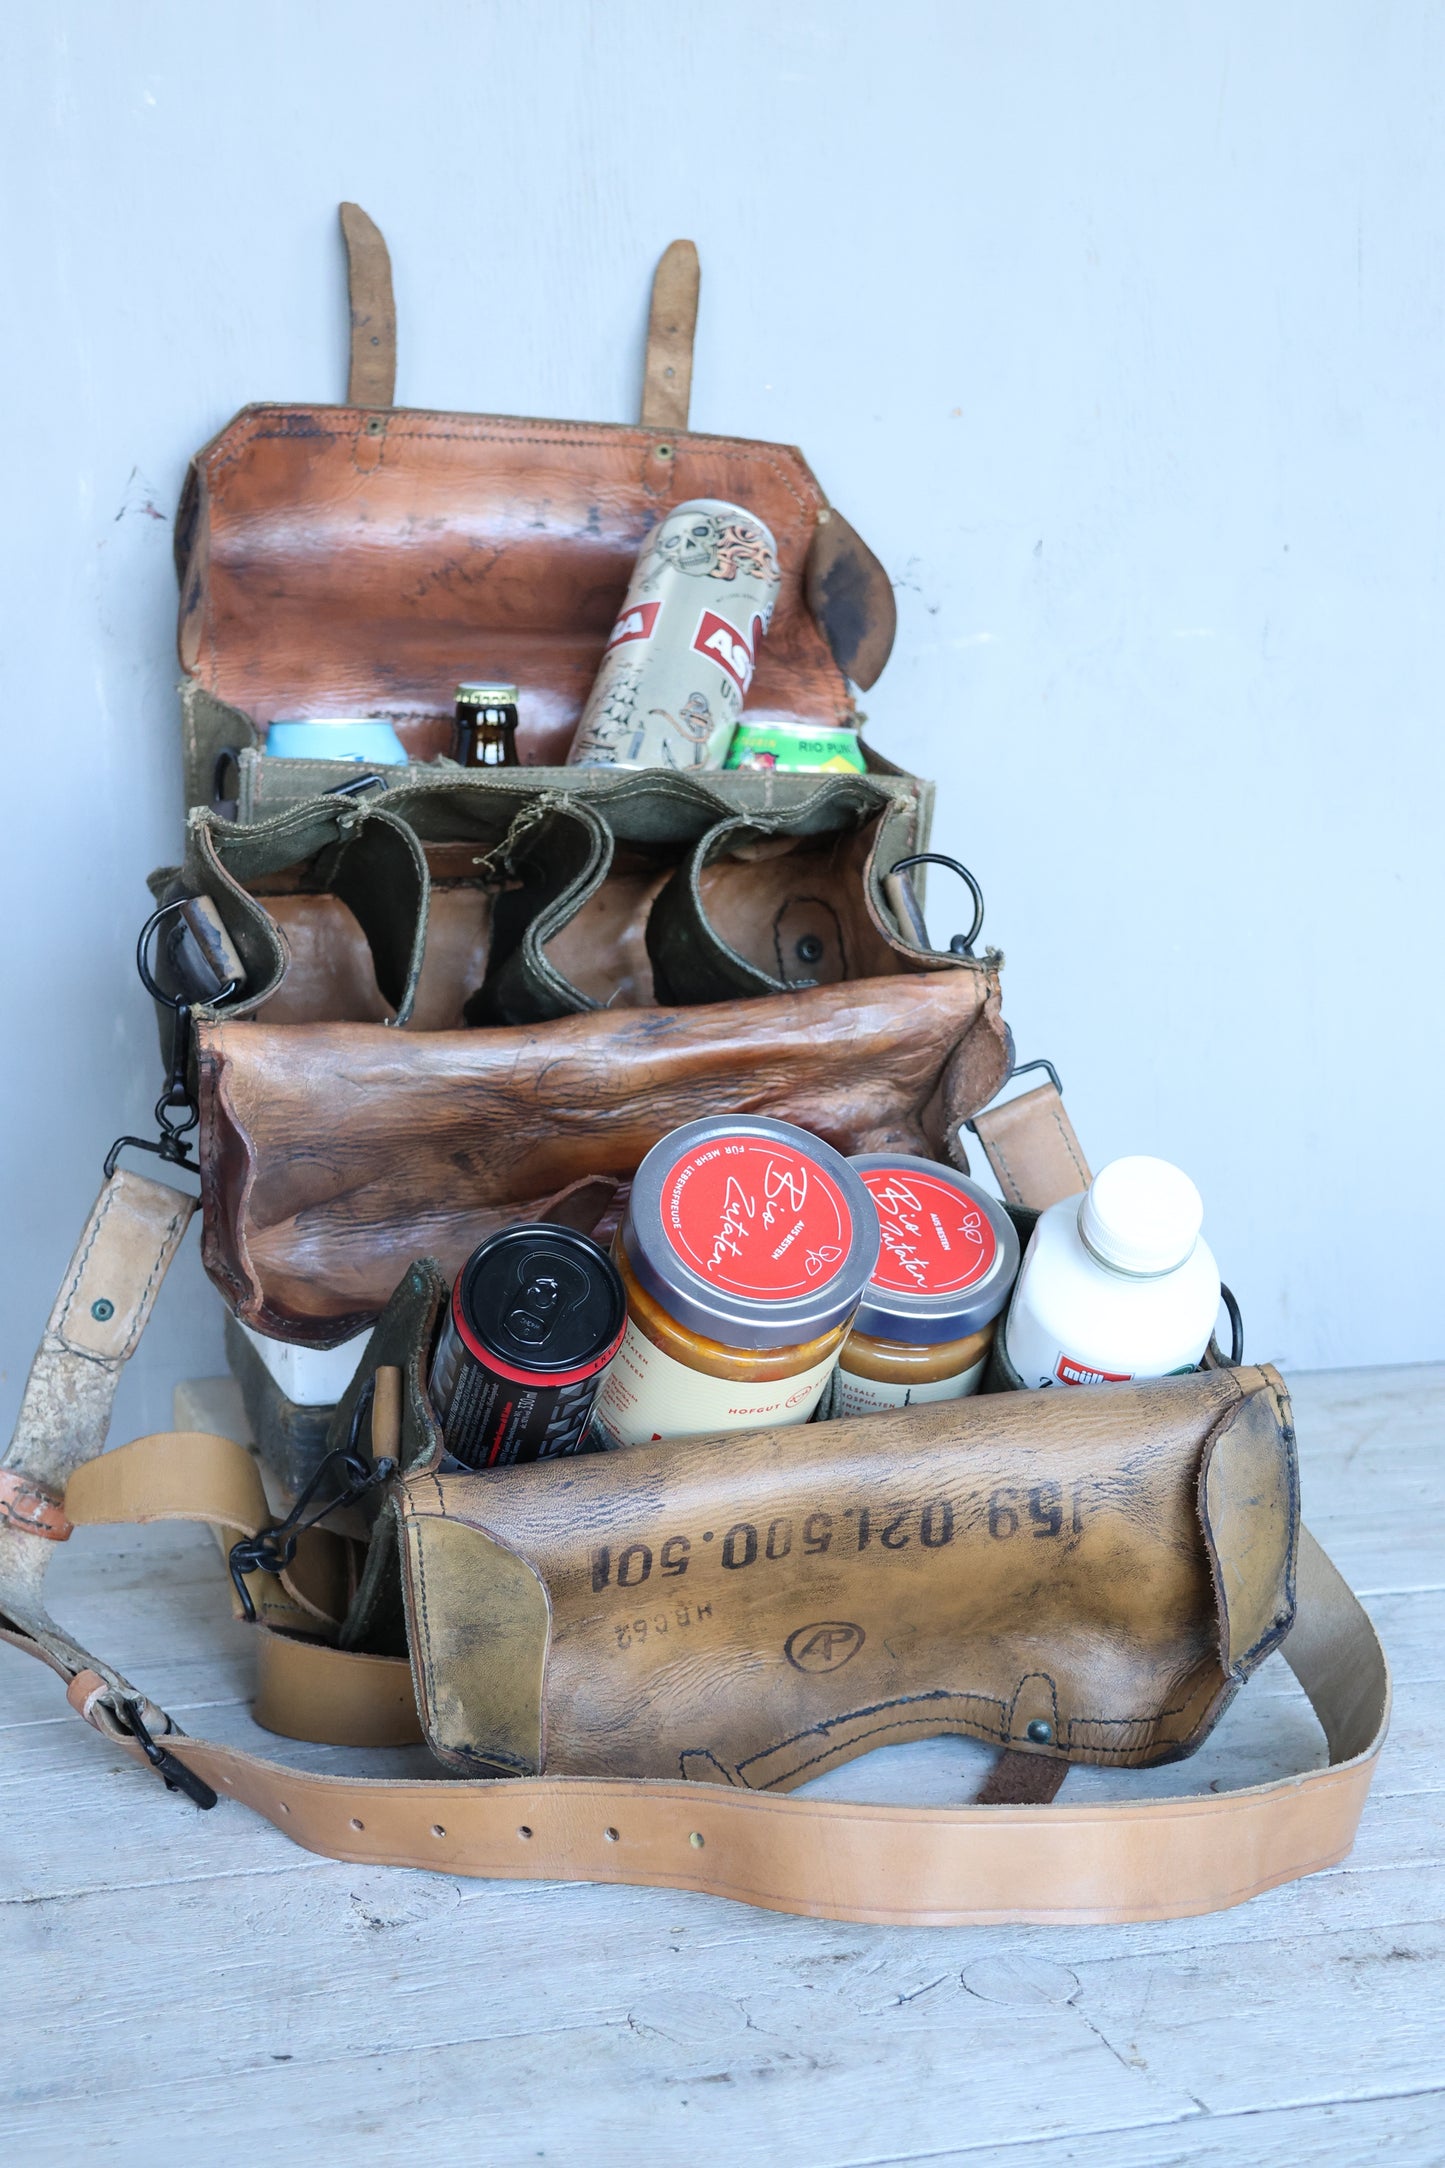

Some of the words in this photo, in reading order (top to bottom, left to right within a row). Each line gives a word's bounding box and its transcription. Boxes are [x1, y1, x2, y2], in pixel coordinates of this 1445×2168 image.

[798, 740, 823, 753] RIO
[694, 1149, 721, 1167] MEHR
[724, 1145, 745, 1155] FÜR
[670, 1165, 696, 1230] LEBENSFREUDE
[762, 1160, 808, 1231] Bio
[867, 1177, 923, 1238] Bio
[706, 1176, 755, 1272] Zutaten
[790, 1220, 805, 1236] AUS
[771, 1233, 795, 1260] BESTEN
[935, 1224, 951, 1251] BESTEN
[1063, 1366, 1104, 1384] müll
[843, 1383, 876, 1398] ELSALZ
[728, 1403, 781, 1415] HOFGUT
